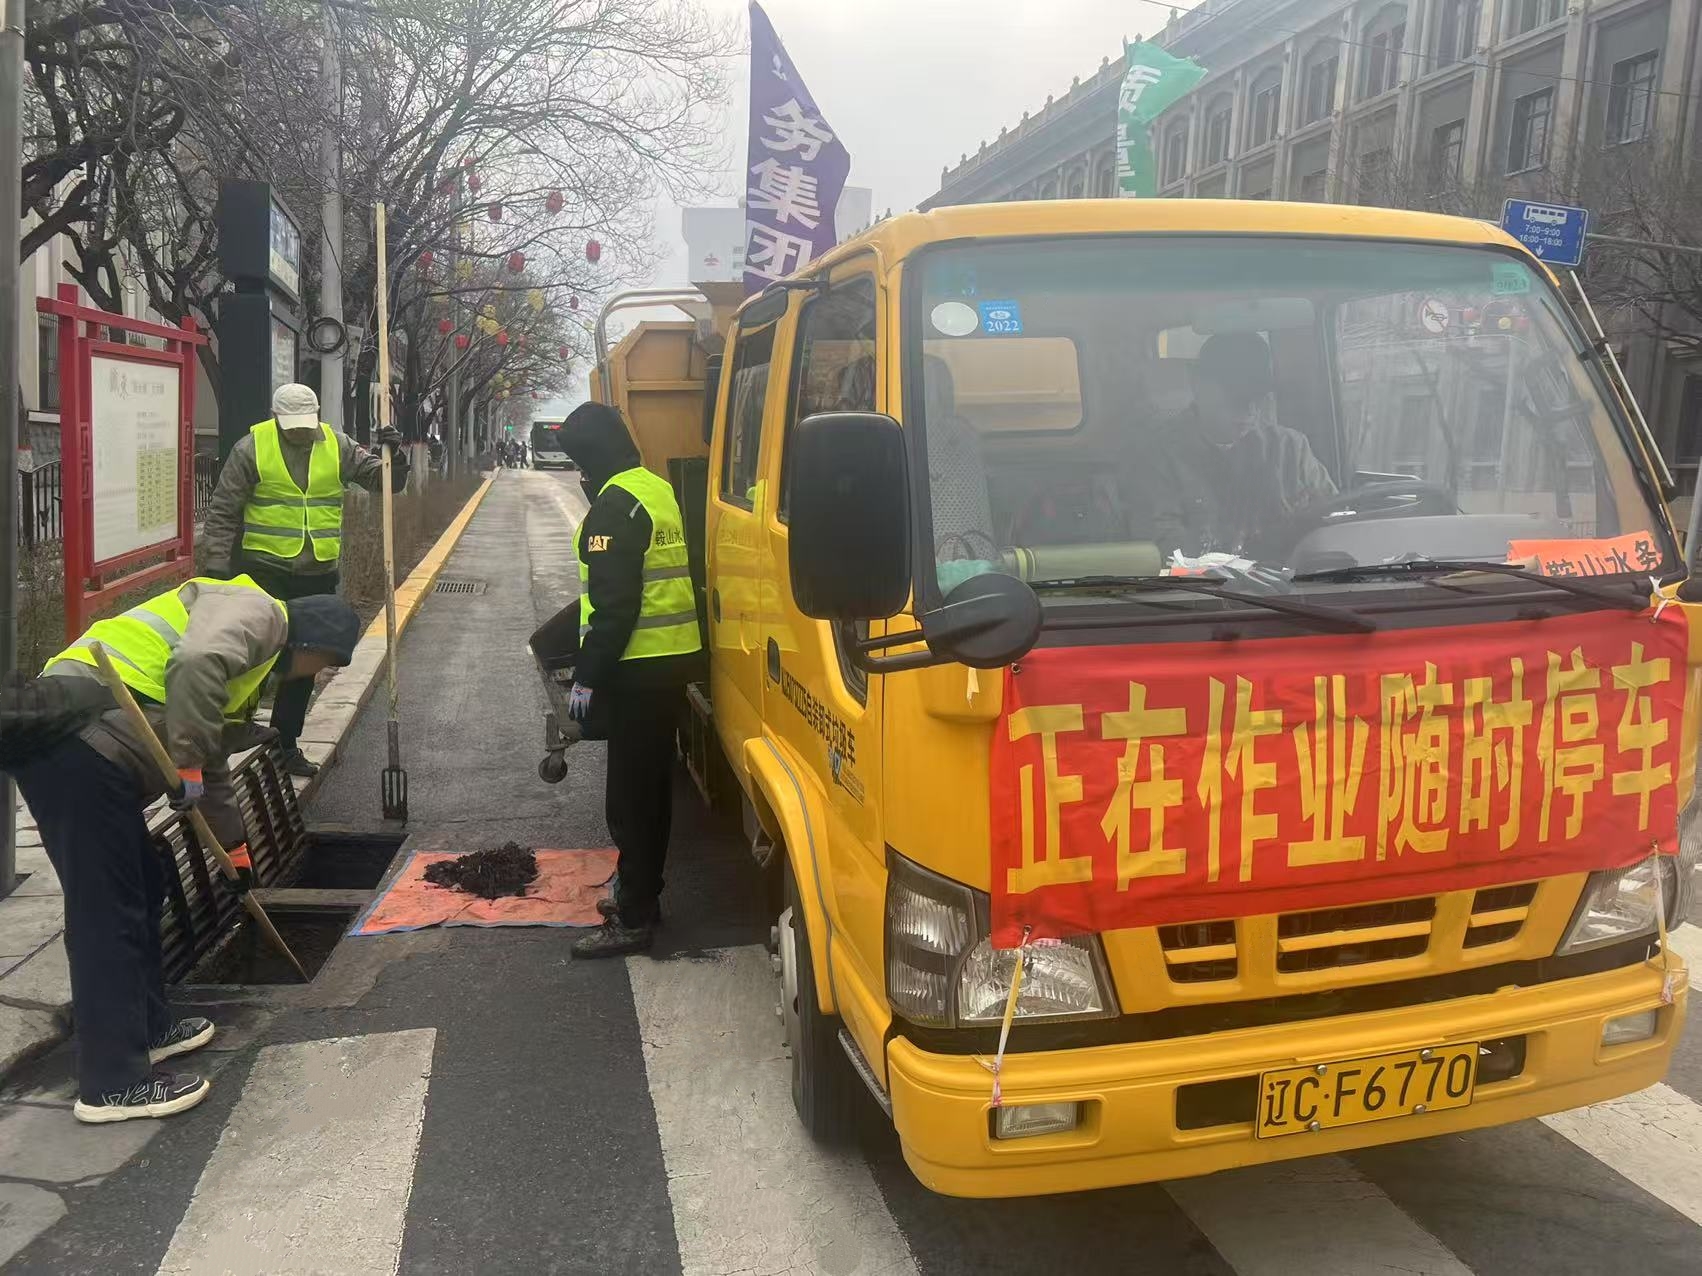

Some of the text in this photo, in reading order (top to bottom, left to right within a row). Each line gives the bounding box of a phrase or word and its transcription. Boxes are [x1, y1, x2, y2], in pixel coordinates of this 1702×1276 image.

[745, 54, 834, 283] 务集团
[1525, 223, 1561, 237] 7:00-9:00
[986, 319, 1020, 332] 2022
[1006, 641, 1672, 895] 正在作业随时停车
[1263, 1053, 1472, 1128] 辽C·F6770
